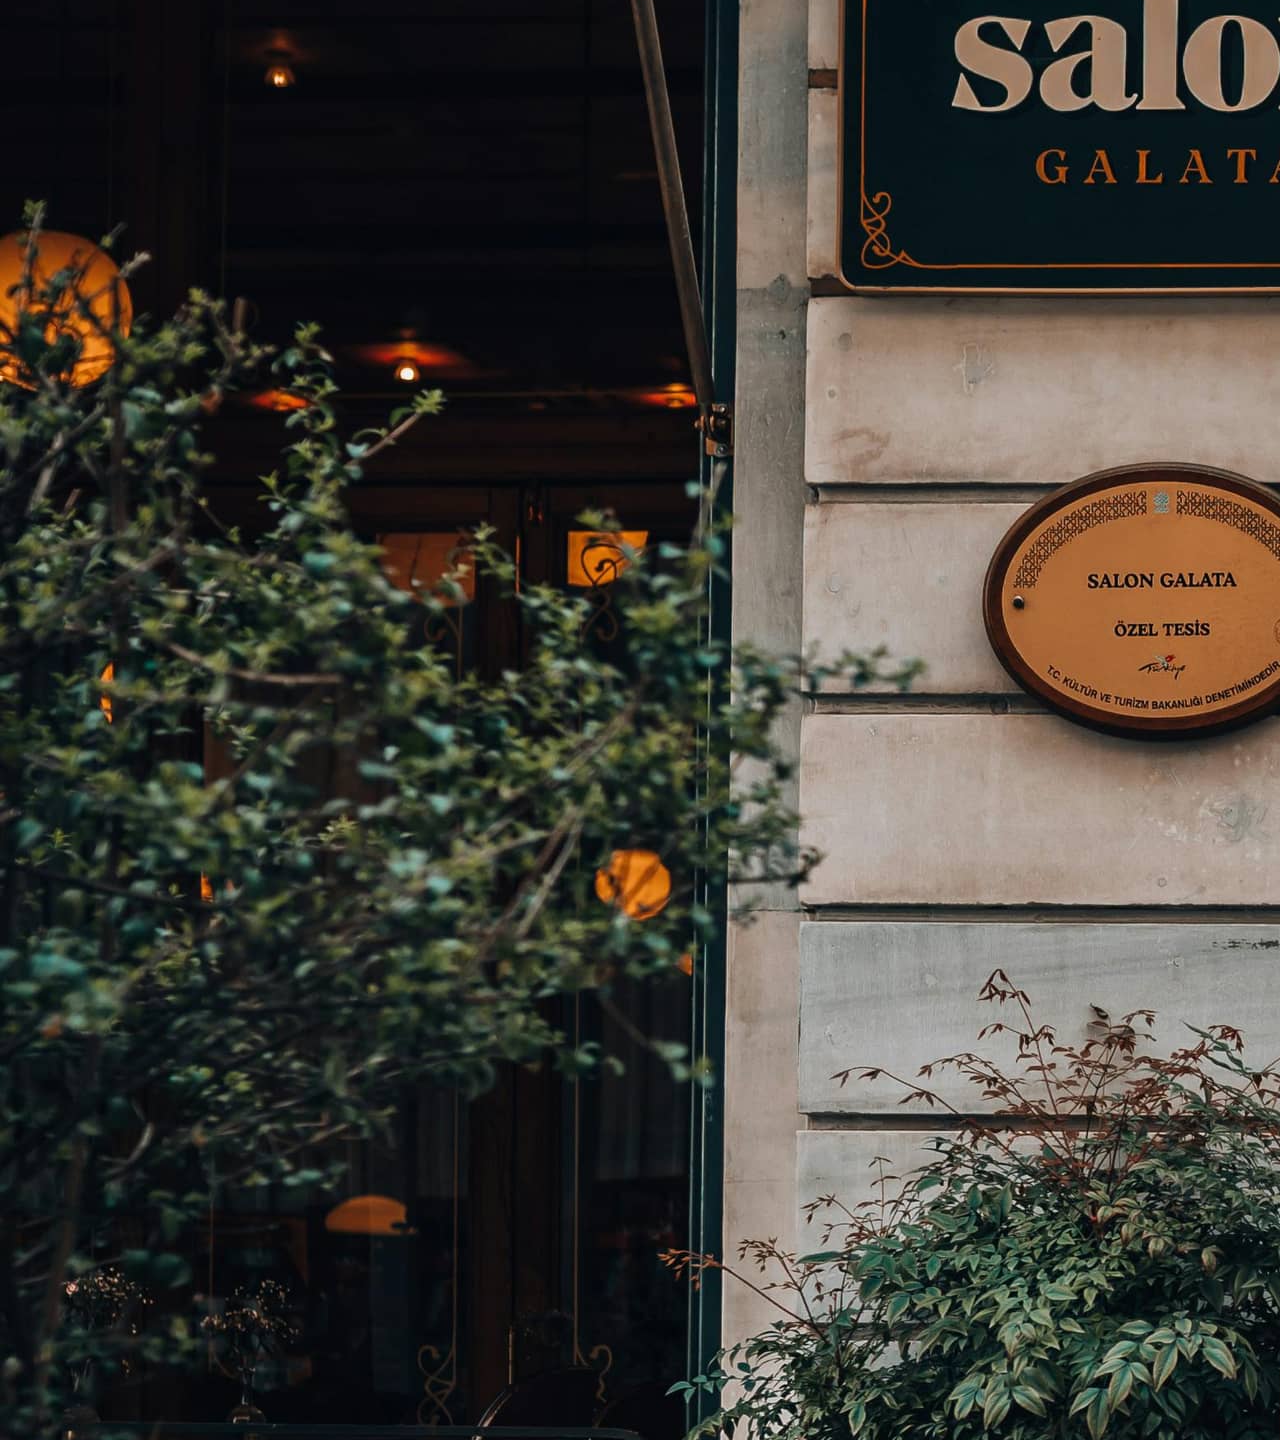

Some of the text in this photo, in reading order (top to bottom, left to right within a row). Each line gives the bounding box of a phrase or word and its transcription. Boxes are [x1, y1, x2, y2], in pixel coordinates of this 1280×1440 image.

[1087, 572, 1237, 588] SALON GALATA
[1114, 619, 1210, 637] ÖZEL TESİS
[1047, 664, 1061, 680] T.C.
[1063, 675, 1098, 699] KÜLTÜR
[1100, 691, 1112, 704] VE
[1114, 695, 1149, 709] TURİZM
[1151, 695, 1203, 709] BAKANLIĞI
